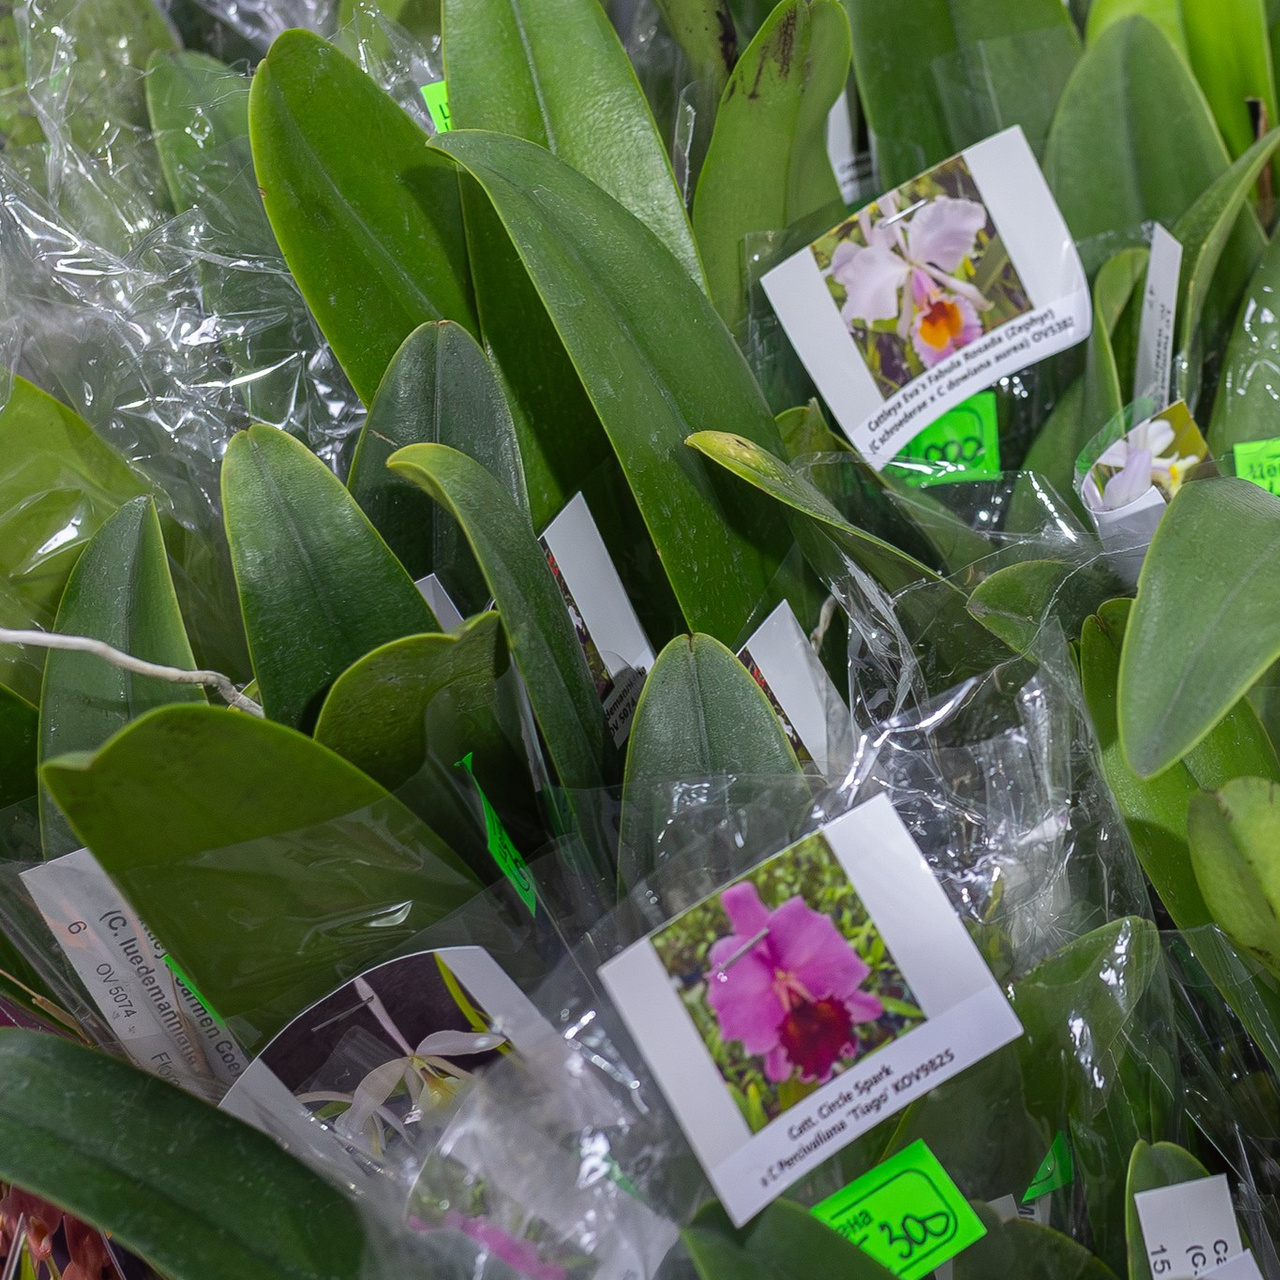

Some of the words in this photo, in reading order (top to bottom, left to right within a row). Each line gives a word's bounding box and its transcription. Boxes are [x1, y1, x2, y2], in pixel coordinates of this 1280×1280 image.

[867, 399, 902, 433] Cattleya
[99, 909, 129, 938] (C.
[67, 920, 88, 936] 6
[95, 962, 117, 985] OV
[108, 986, 138, 1019] 5074
[892, 1048, 956, 1095] KOV9825
[816, 1089, 854, 1121] Circle
[853, 1063, 894, 1098] Spark
[1150, 1244, 1172, 1275] 15
